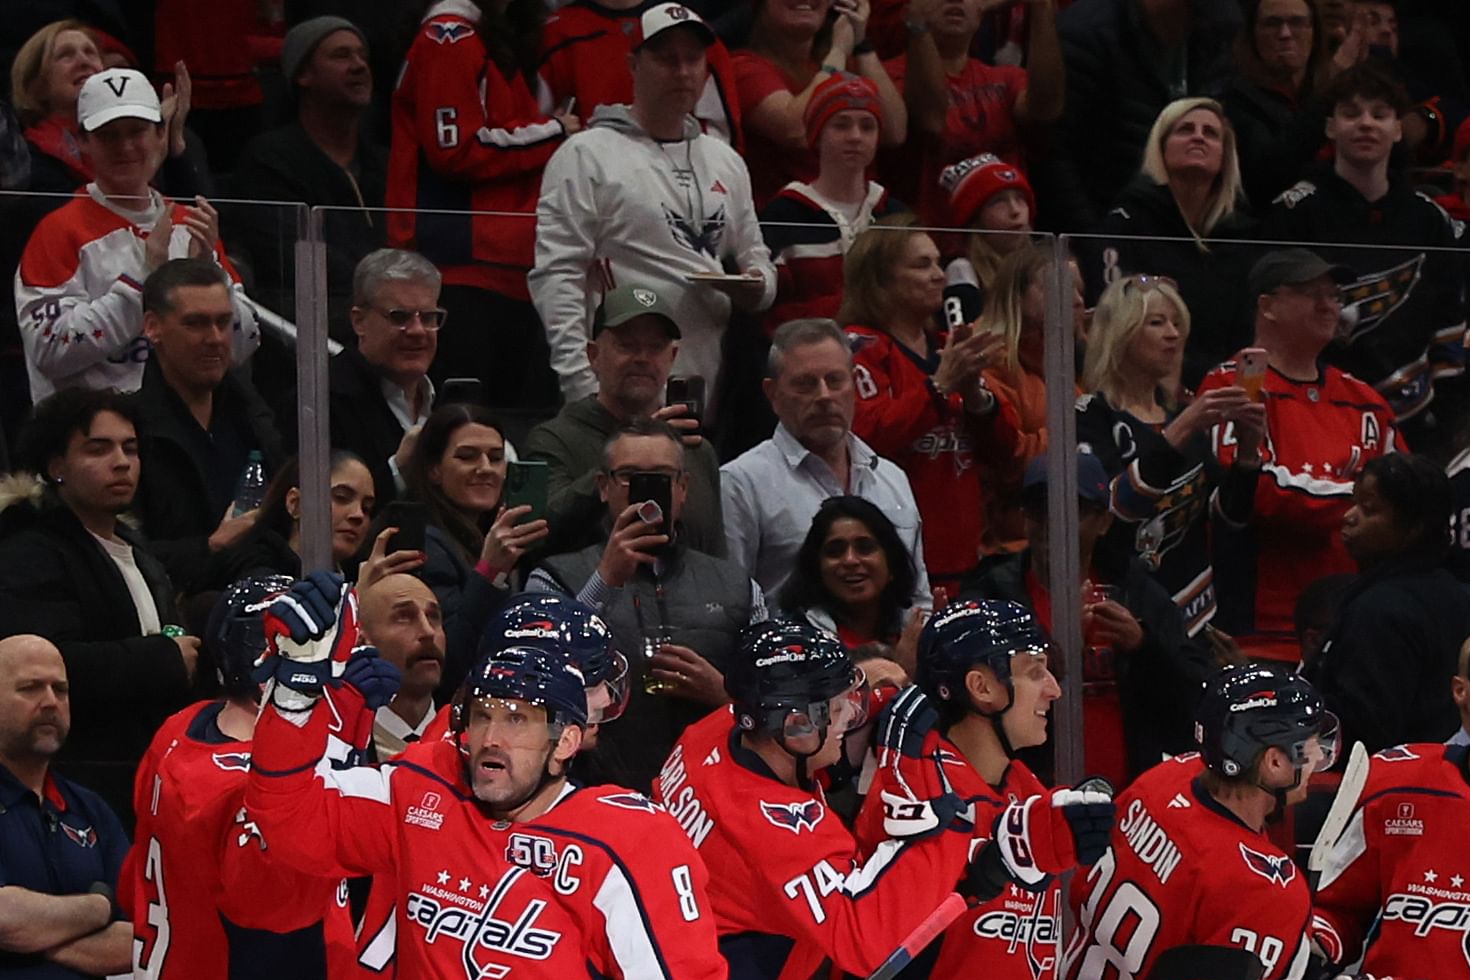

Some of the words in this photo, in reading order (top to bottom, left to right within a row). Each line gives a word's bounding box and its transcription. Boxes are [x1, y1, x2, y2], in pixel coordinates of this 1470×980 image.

[104, 77, 130, 97] V
[436, 108, 458, 148] 6
[1362, 411, 1380, 450] A
[407, 806, 444, 823] CAESARS
[658, 744, 715, 850] CARLSON
[1119, 799, 1182, 884] SANDIN
[1384, 820, 1424, 828] CAESARS
[512, 837, 554, 868] 50
[554, 845, 583, 894] C
[421, 883, 484, 912] WASHINGTON
[672, 865, 700, 922] 8
[784, 860, 849, 924] 74
